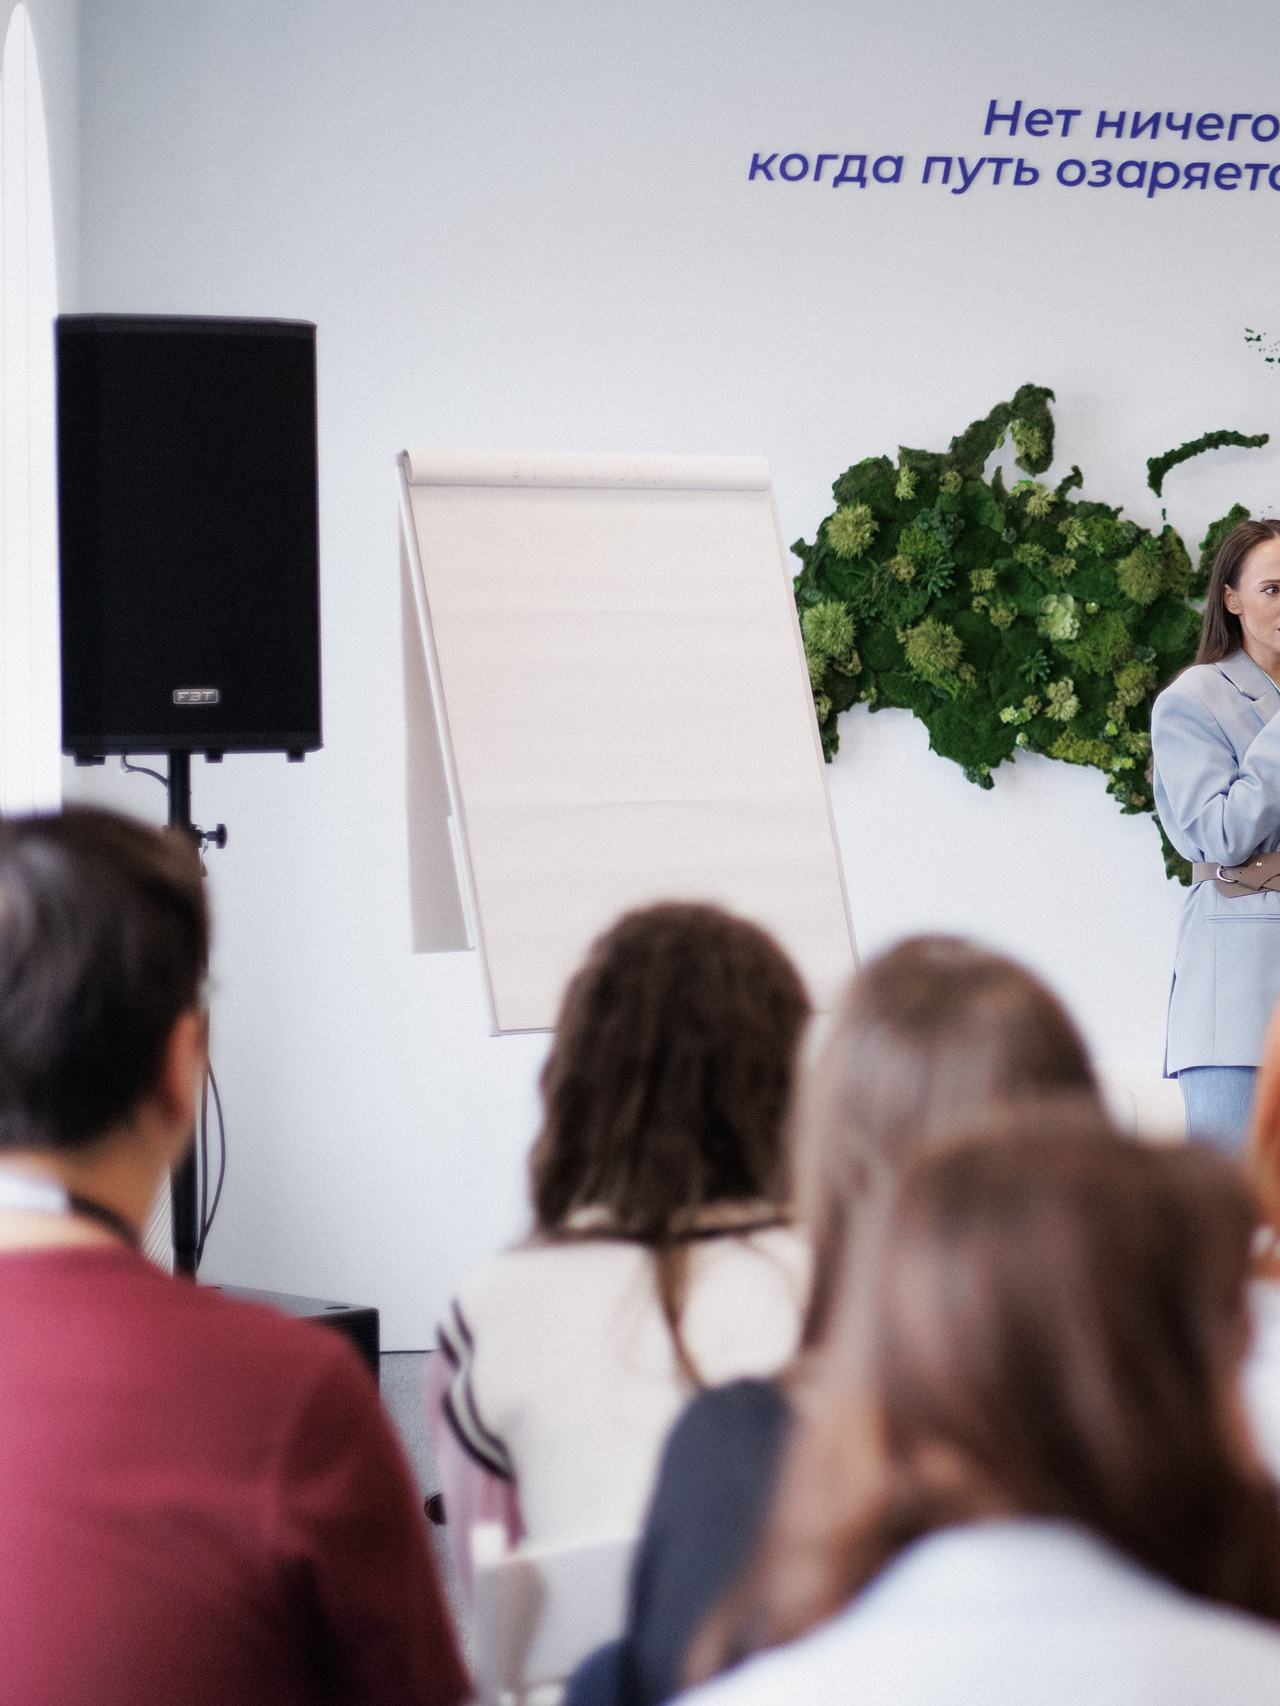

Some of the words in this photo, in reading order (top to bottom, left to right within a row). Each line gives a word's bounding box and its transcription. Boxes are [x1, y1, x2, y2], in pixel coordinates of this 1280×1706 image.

[984, 99, 1081, 137] Нет
[1096, 110, 1280, 142] ничего
[748, 152, 903, 188] когда
[921, 155, 1040, 194] путь
